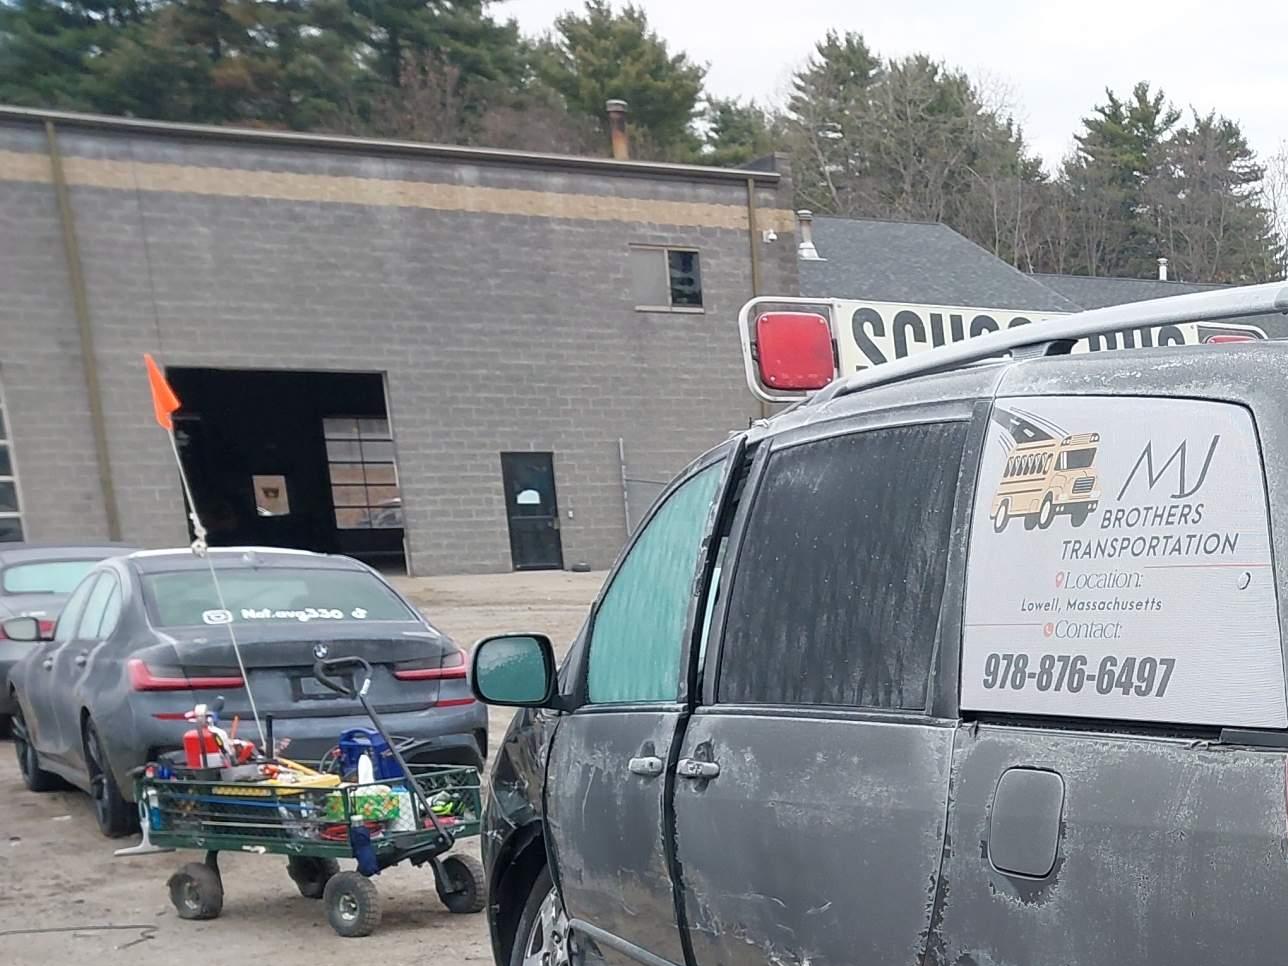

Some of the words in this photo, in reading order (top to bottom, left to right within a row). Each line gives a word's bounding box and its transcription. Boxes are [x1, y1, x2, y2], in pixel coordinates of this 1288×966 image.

[1117, 434, 1220, 501] MJ
[1100, 503, 1205, 530] BROTHERS
[1061, 532, 1239, 561] TRANSPORTATION
[1064, 570, 1144, 590] Location:
[1021, 598, 1062, 613] Lowell,
[1066, 597, 1162, 612] Massachusetts
[1055, 618, 1123, 640] Contact:
[982, 652, 1176, 698] 978-876-6497
